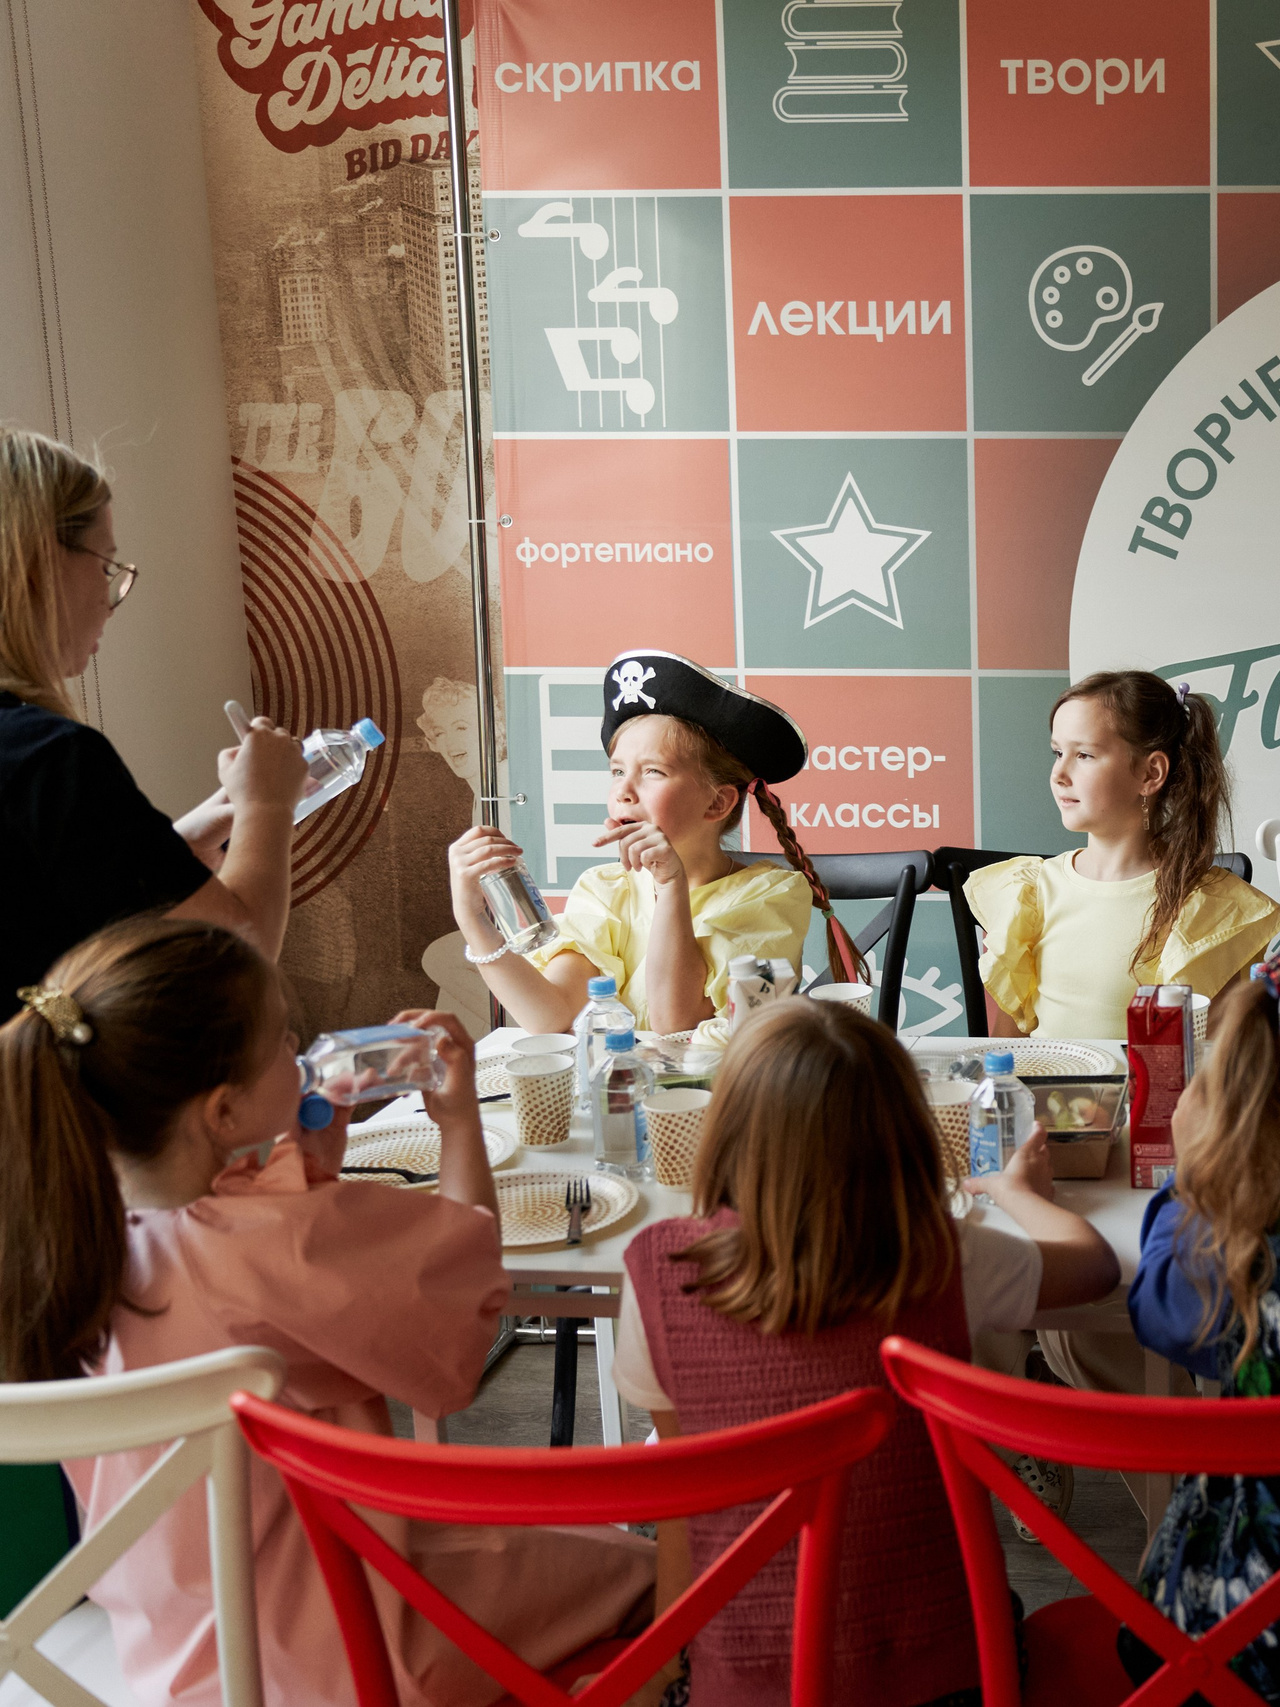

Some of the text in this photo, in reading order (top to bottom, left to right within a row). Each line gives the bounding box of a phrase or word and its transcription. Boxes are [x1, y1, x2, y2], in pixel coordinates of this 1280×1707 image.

[267, 44, 446, 132] Delta
[494, 59, 702, 102] скрипка
[999, 58, 1166, 105] твори
[344, 138, 402, 182] BID
[747, 300, 953, 343] лекции
[515, 537, 714, 569] фортепиано
[790, 799, 940, 829] классы
